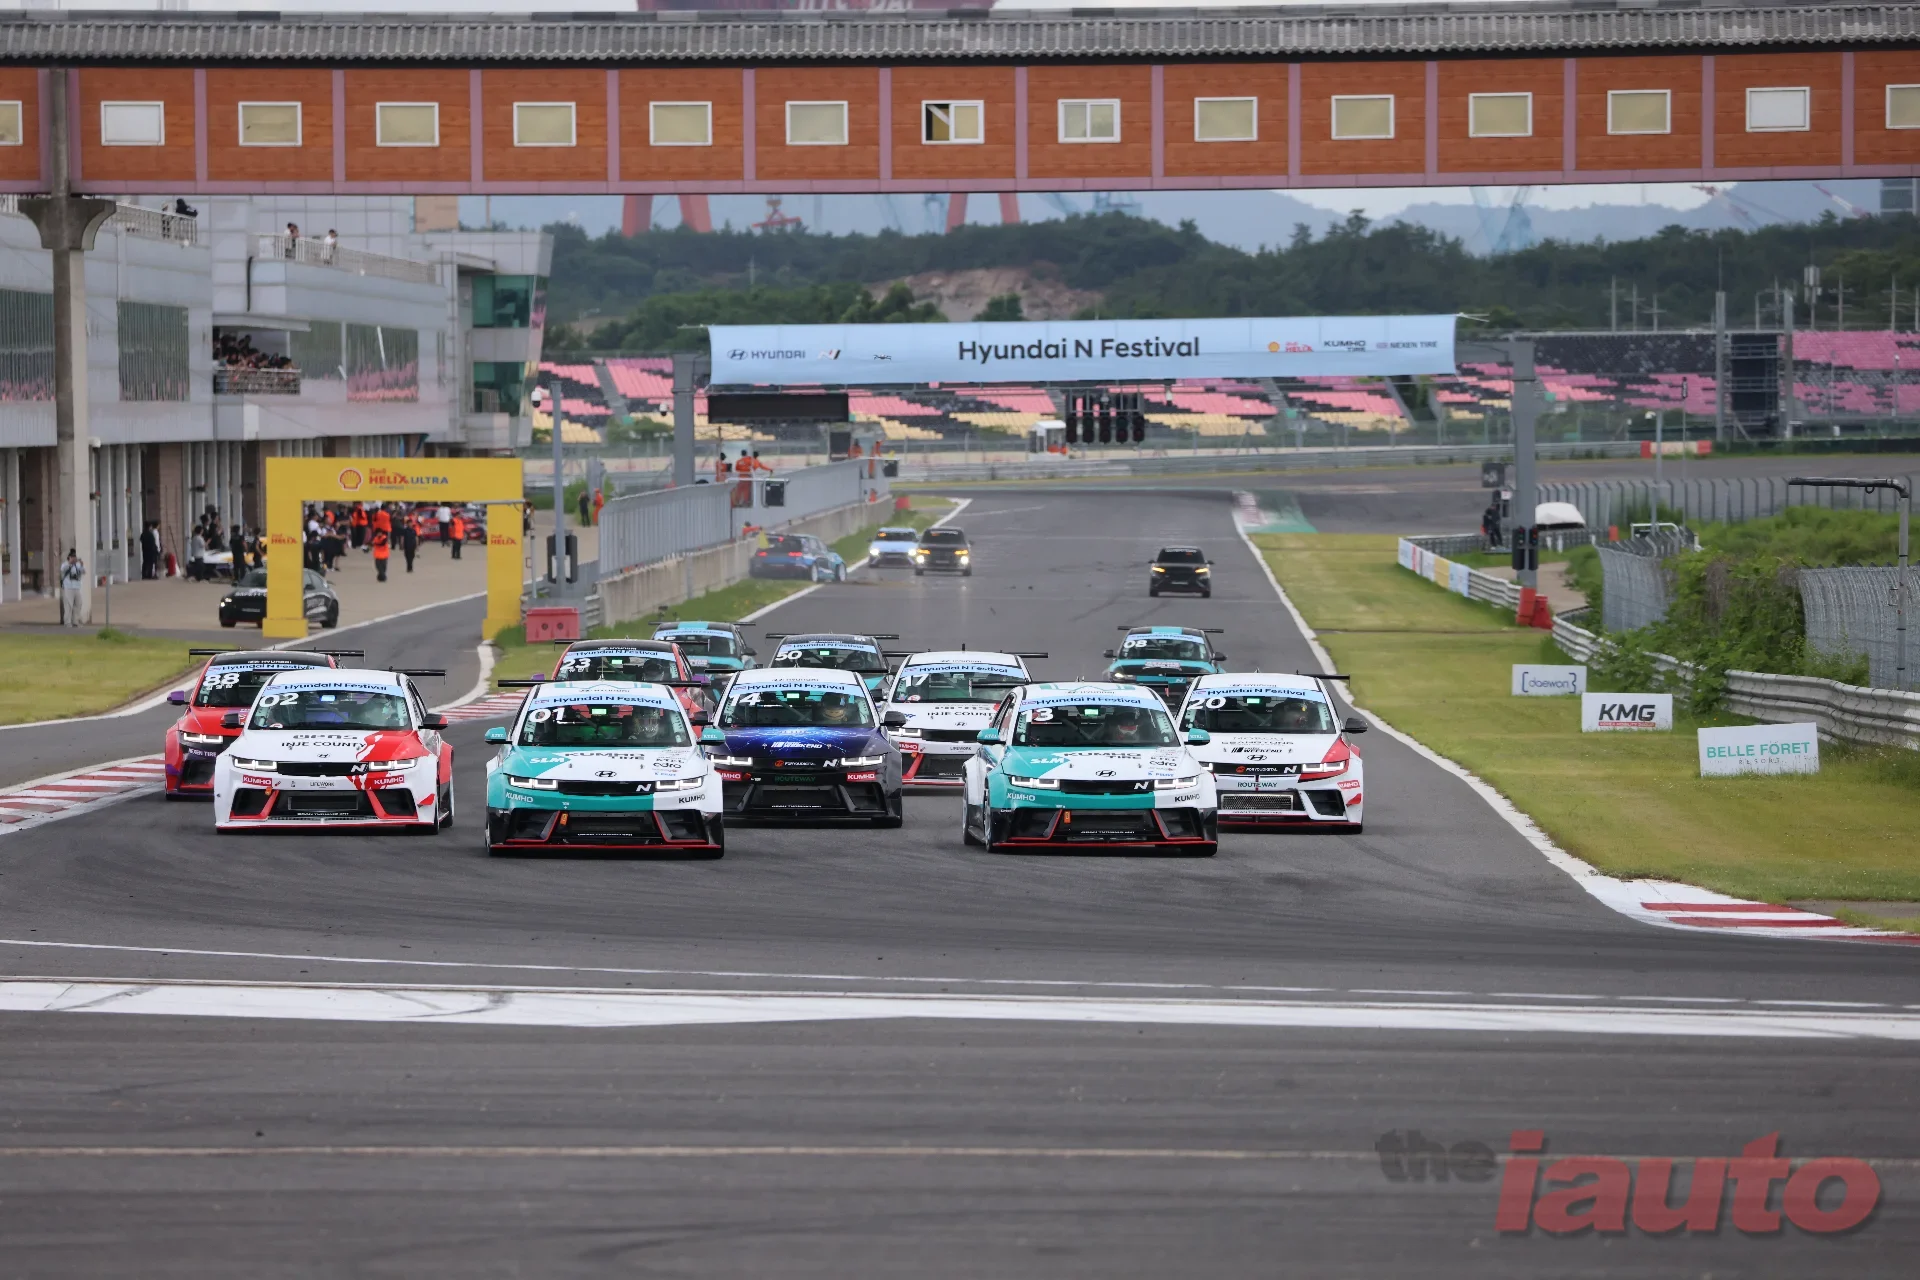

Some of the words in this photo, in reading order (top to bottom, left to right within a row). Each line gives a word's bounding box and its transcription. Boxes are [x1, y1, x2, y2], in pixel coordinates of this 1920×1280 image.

[958, 338, 1067, 364] Hyundai
[1074, 339, 1093, 359] N
[1101, 337, 1200, 358] Festival
[1390, 341, 1417, 349] NEXEN
[751, 349, 806, 360] HYUNDAI
[368, 473, 410, 485] HELIX
[410, 476, 449, 485] ULTRA
[1123, 640, 1147, 648] 08
[775, 650, 803, 661] 50
[560, 658, 591, 671] 23
[202, 672, 241, 687] 88
[901, 673, 929, 687] 17
[344, 683, 387, 691] Festival
[747, 683, 793, 691] Hyundai
[804, 683, 845, 691] Festival
[258, 693, 300, 708] 02
[553, 695, 603, 703] Hyundai
[617, 696, 662, 704] Festival
[729, 692, 762, 707] 14
[1036, 697, 1085, 705] Hyundai
[1186, 697, 1227, 710] 20
[528, 707, 566, 723] 01
[1020, 706, 1054, 722] 13
[1598, 703, 1656, 722] KMG
[1706, 744, 1756, 758] BELLE
[529, 756, 565, 765] SLM
[243, 776, 272, 785] KUMHO
[374, 776, 405, 785] KUMHO
[505, 791, 534, 803] KUMHO
[678, 793, 706, 804] KUMHO
[1006, 792, 1036, 802] KUMHO
[1174, 793, 1200, 803] KUMHO
